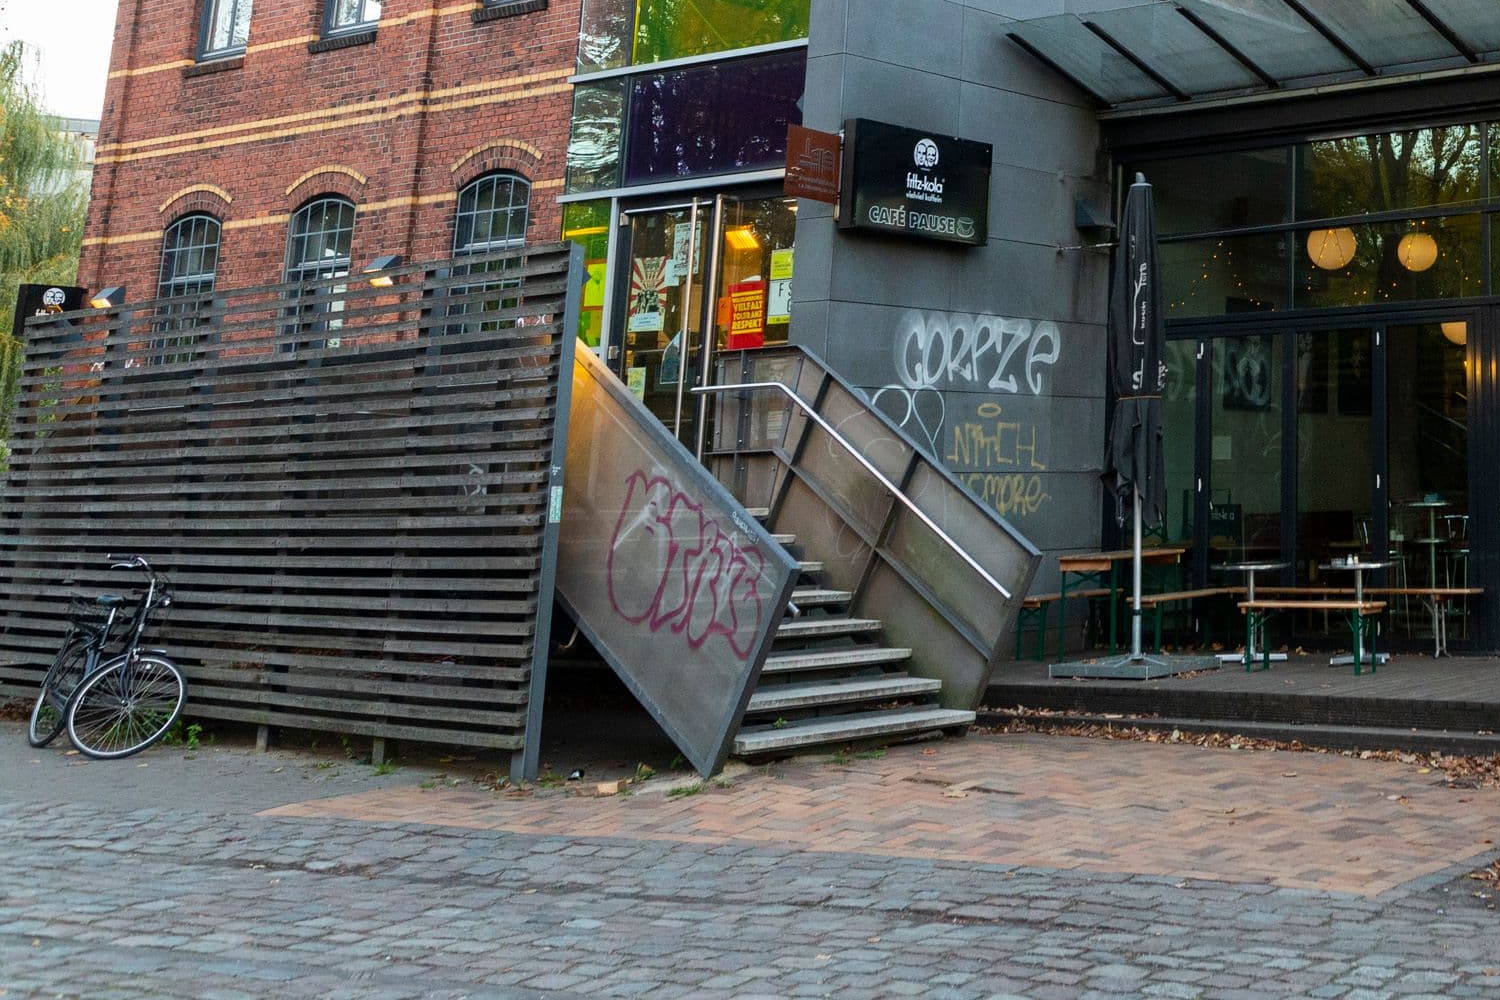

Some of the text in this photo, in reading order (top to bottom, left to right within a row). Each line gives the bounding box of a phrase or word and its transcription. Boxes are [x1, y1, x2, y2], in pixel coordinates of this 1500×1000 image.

[868, 205, 955, 234] CAFÉ PAUSE
[731, 318, 763, 330] RESPEKT
